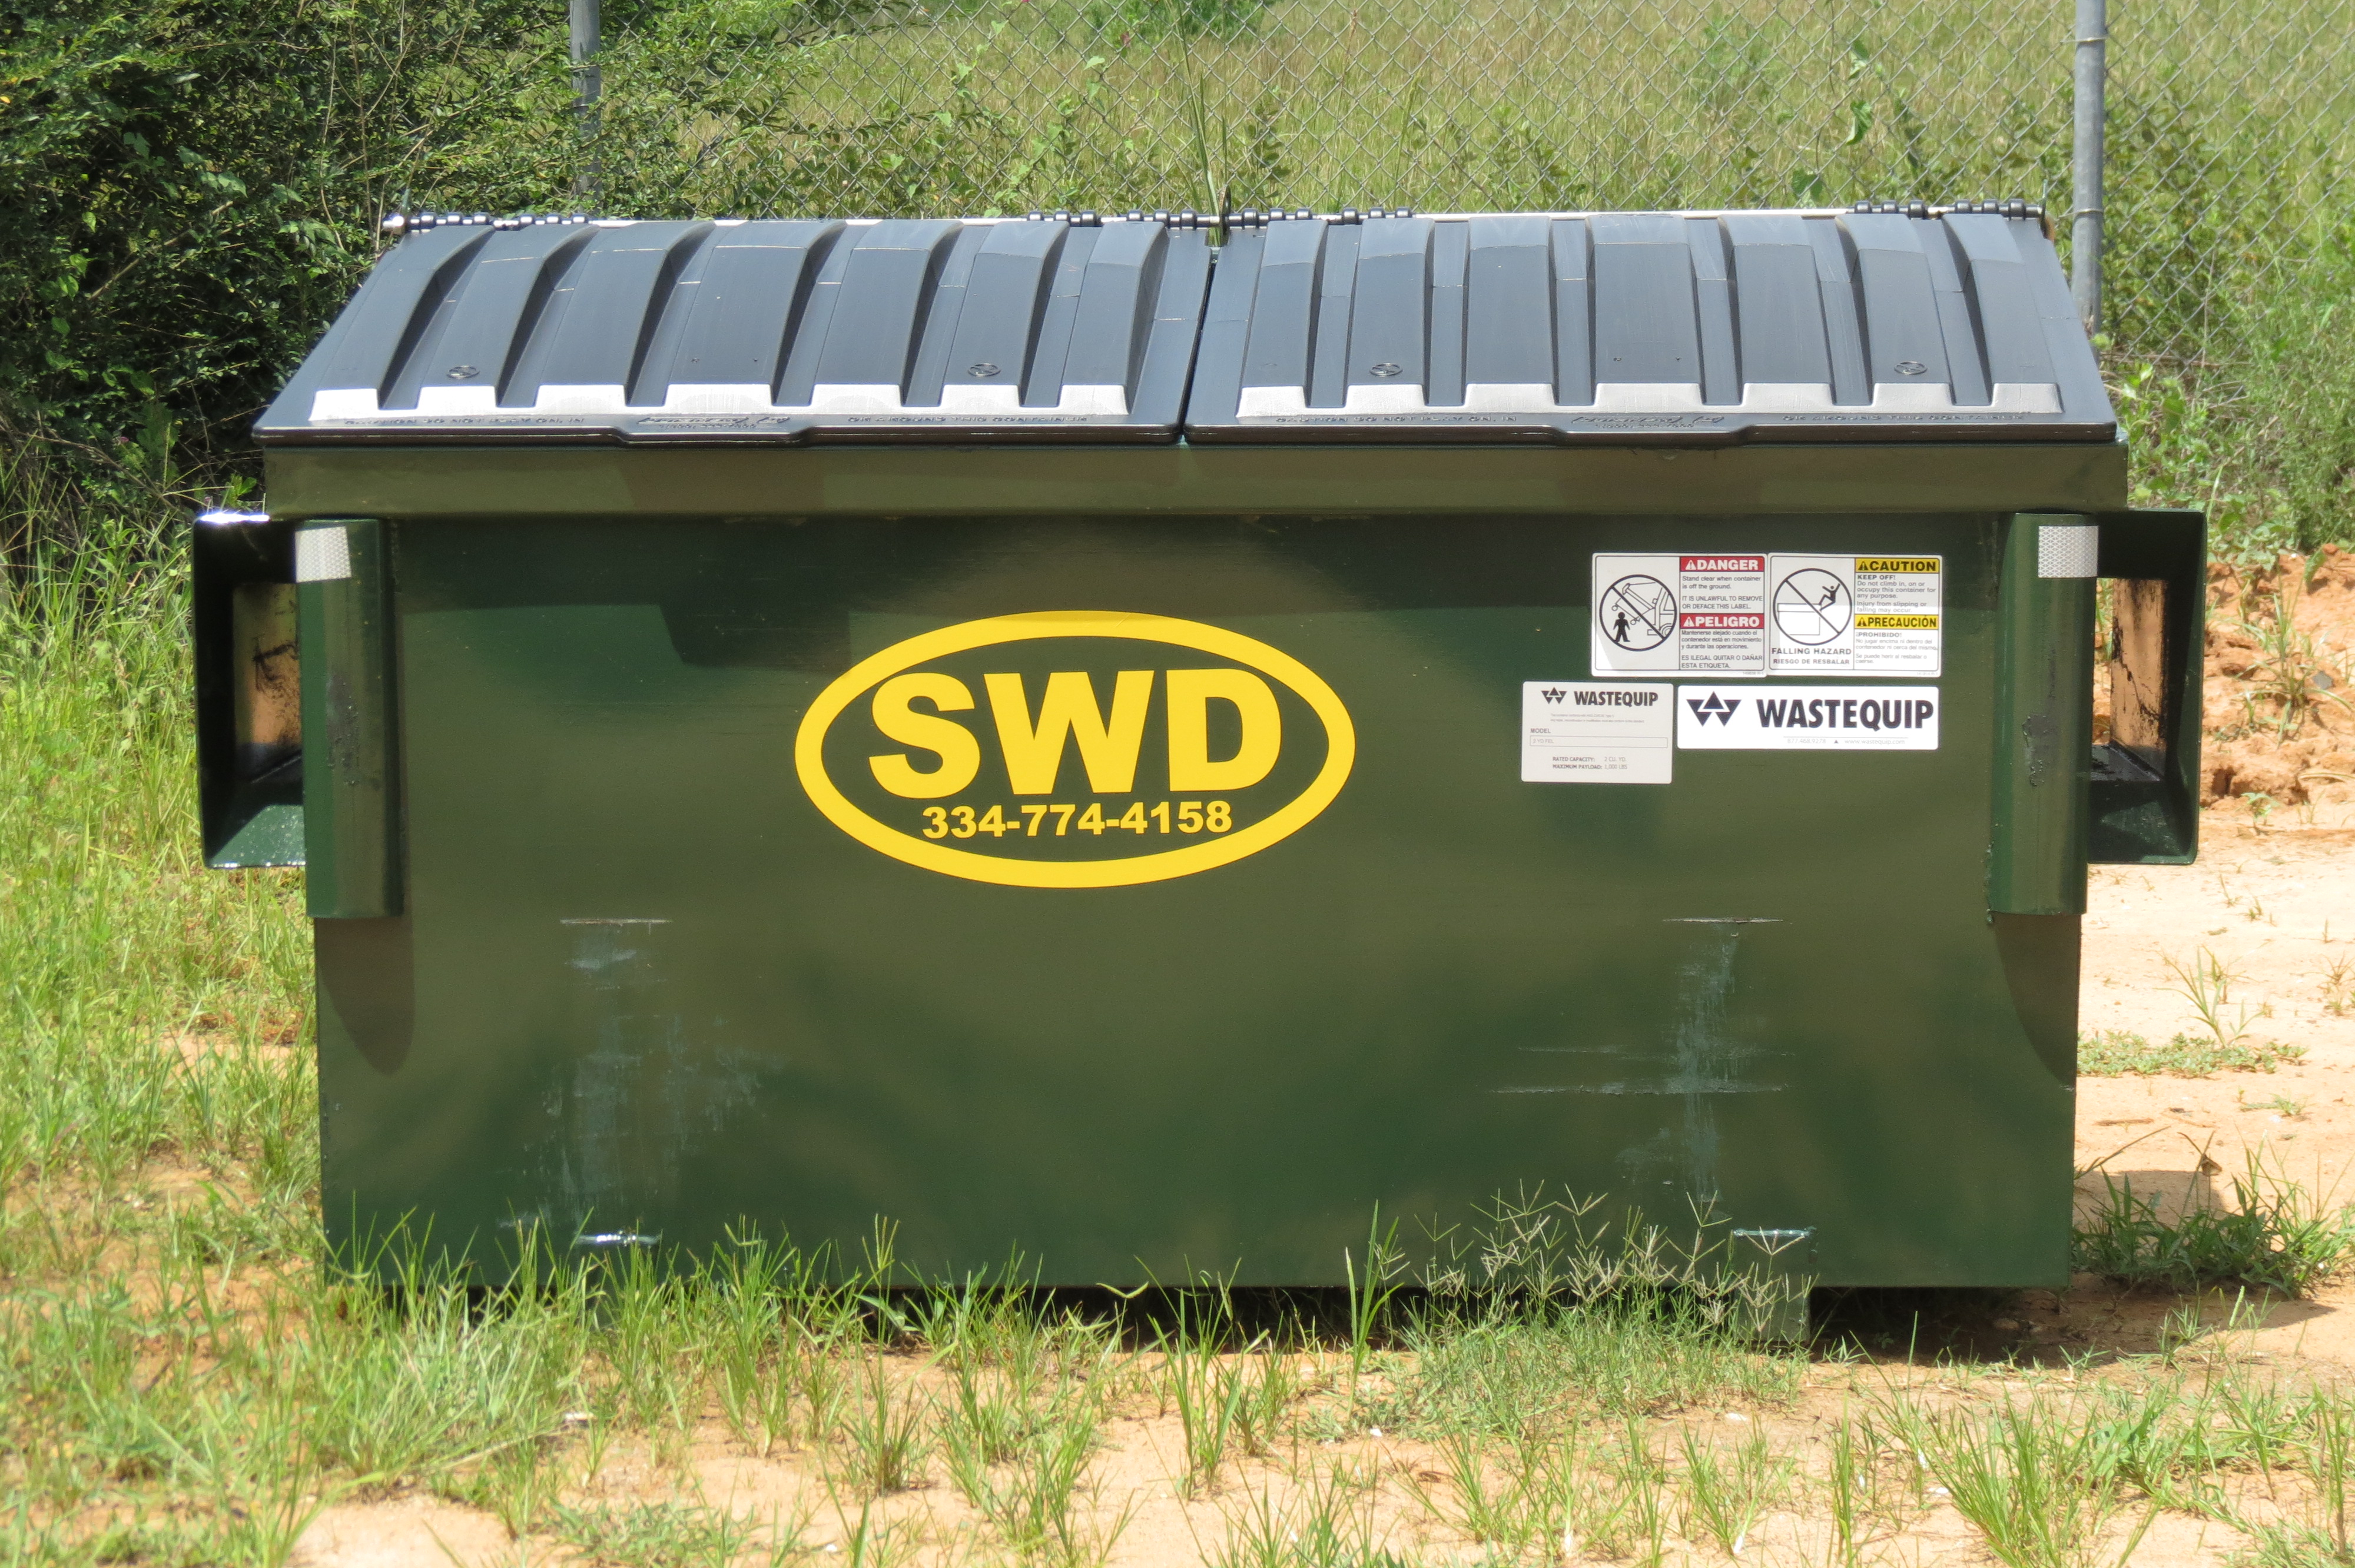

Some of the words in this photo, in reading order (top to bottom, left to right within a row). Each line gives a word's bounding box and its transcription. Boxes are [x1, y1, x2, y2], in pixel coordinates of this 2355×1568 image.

[1697, 559, 1759, 571] DANGER
[1869, 561, 1937, 572] CAUTION
[1694, 616, 1760, 627] PELIGRO
[1868, 614, 1937, 628] PRECAUCIÓN
[1742, 653, 1763, 661] DAÑAR
[1574, 690, 1659, 707] WASTEQUIP
[1756, 698, 1935, 732] WASTEQUIP
[868, 668, 1282, 799] SWD
[922, 800, 1232, 838] 334-774-4158
